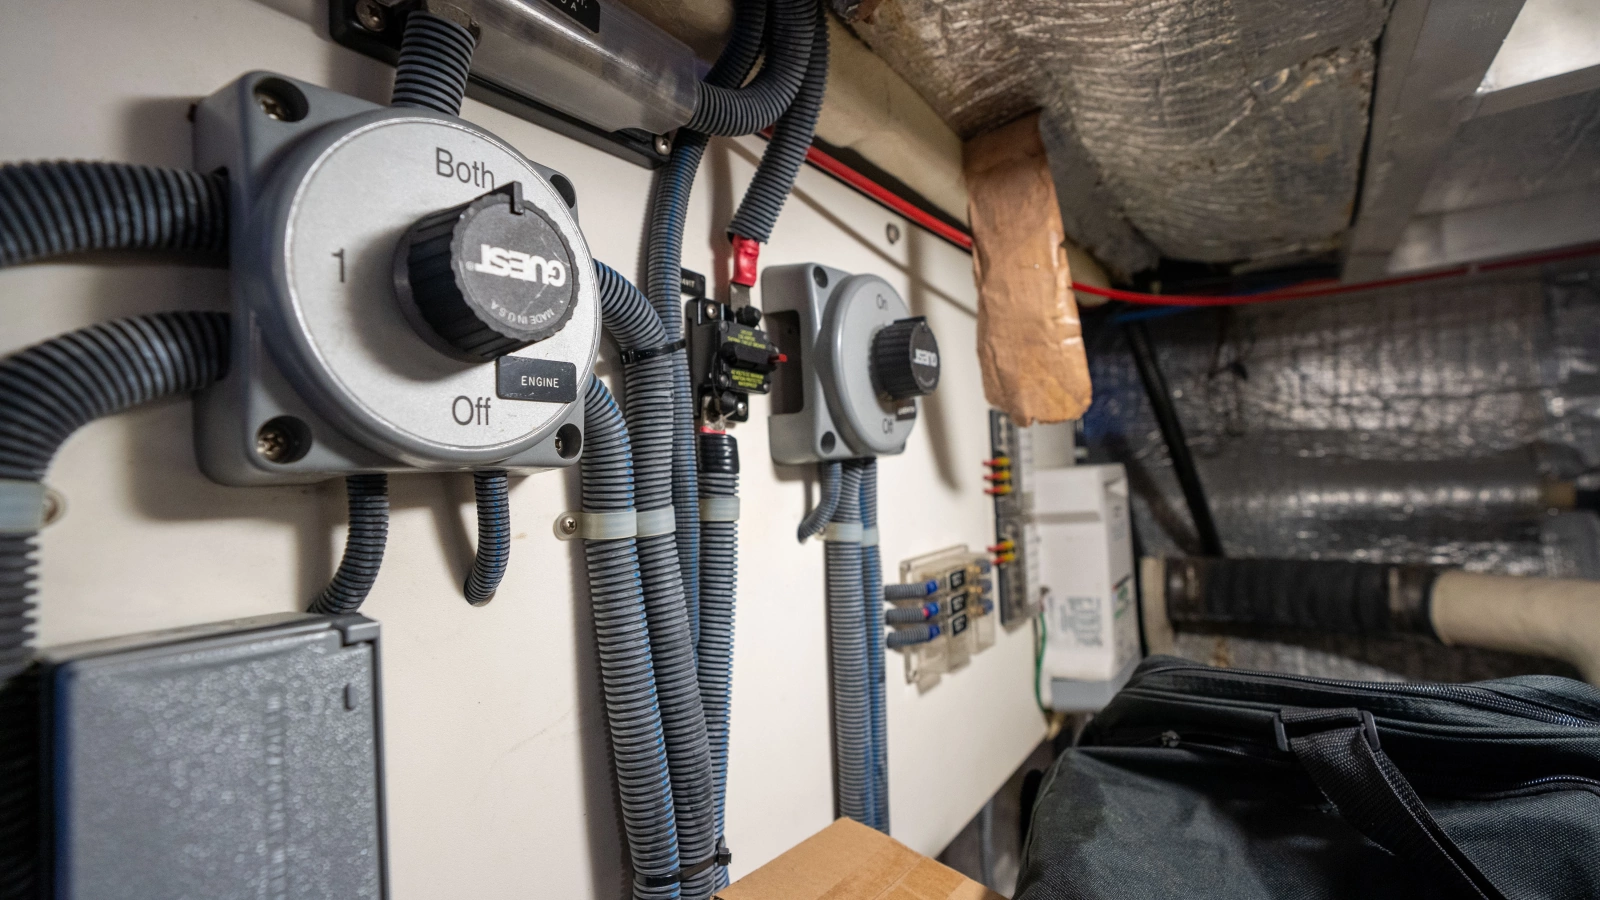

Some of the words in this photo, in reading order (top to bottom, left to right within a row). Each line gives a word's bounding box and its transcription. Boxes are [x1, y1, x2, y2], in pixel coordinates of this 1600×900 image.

[436, 147, 495, 190] Both
[331, 248, 345, 283] 1
[474, 244, 566, 287] GUEST
[876, 294, 889, 311] On
[518, 314, 529, 325] IN
[529, 308, 555, 325] MADE
[520, 375, 560, 389] ENGINE
[452, 395, 491, 426] Off
[882, 417, 894, 434] Off
